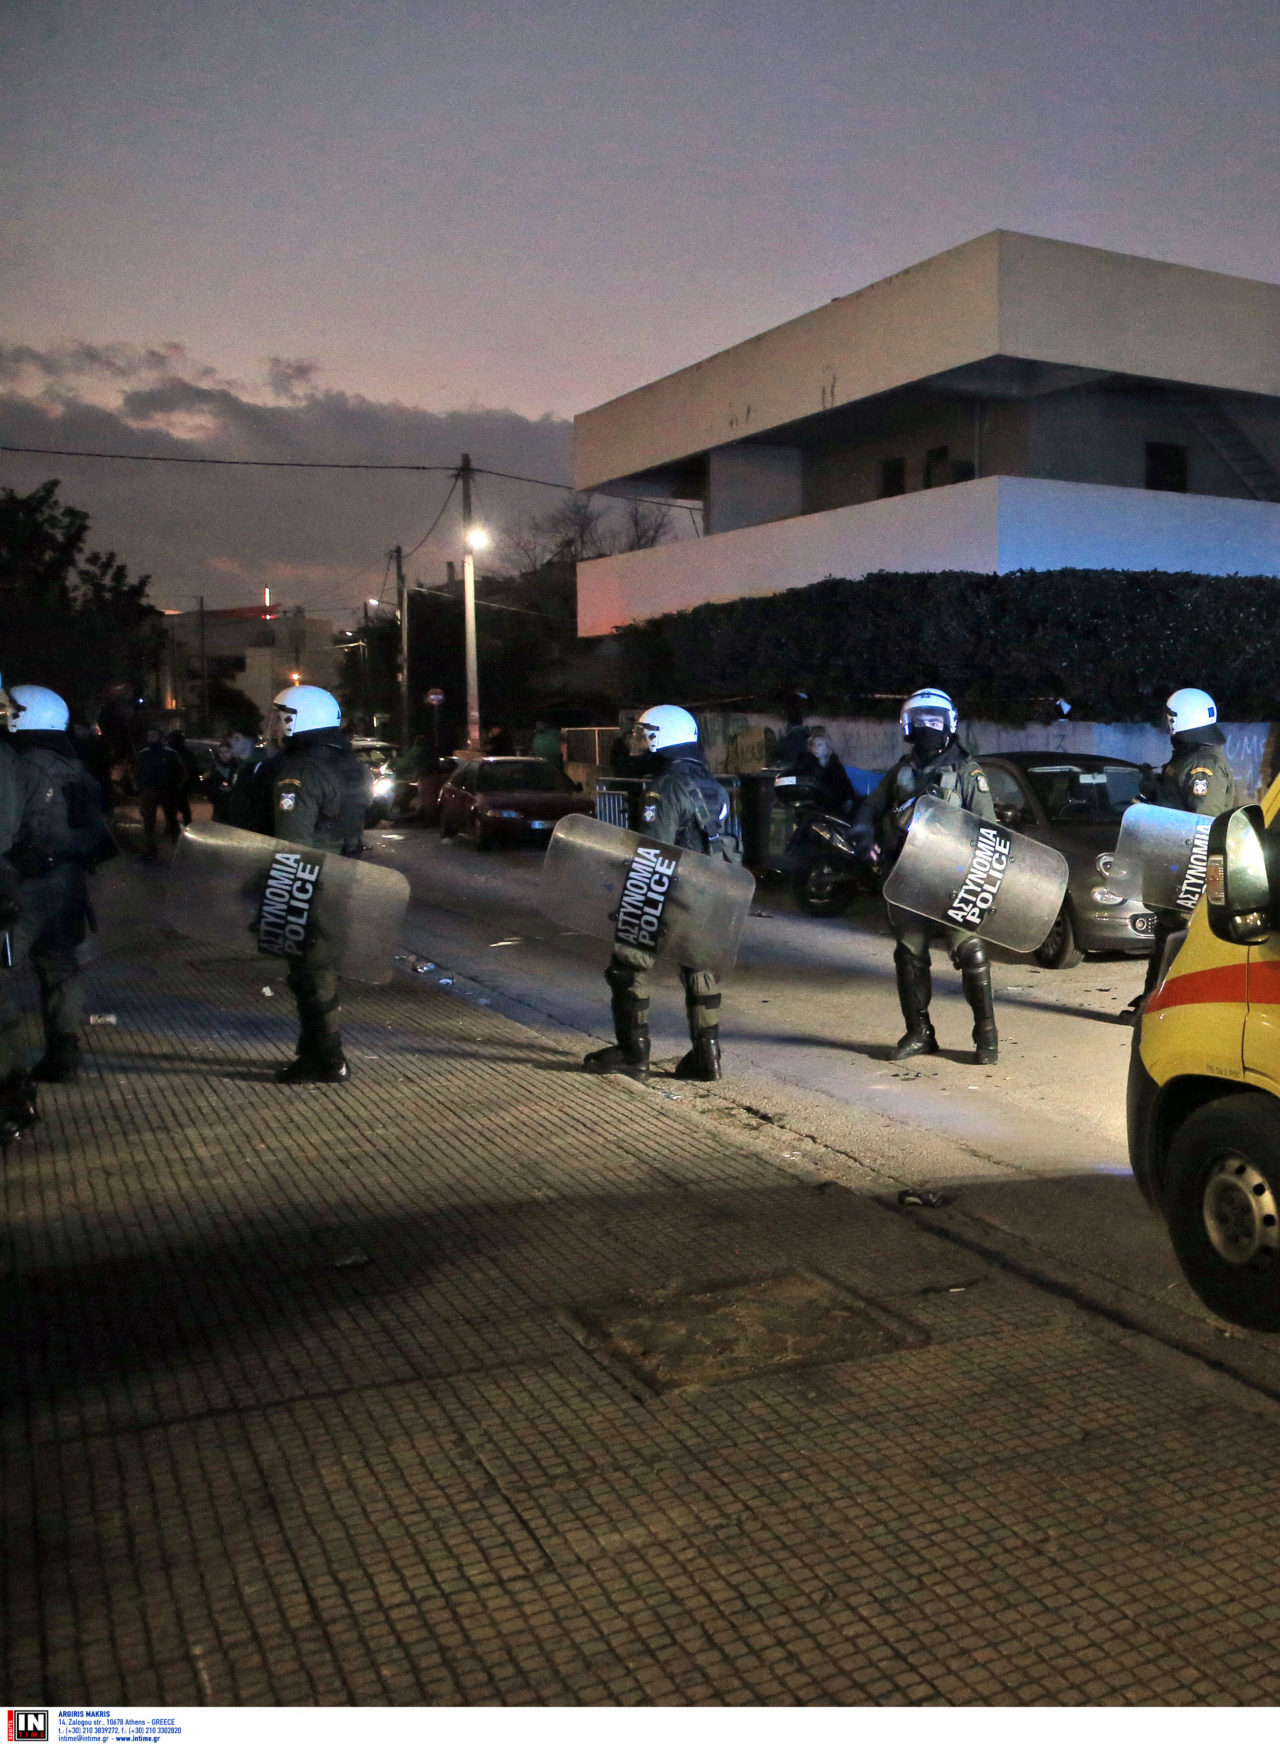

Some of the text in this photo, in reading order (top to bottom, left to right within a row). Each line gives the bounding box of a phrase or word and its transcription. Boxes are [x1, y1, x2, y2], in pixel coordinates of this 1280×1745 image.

[259, 853, 301, 953] ΑΣΤΥΝΟΜΙΑ
[284, 862, 319, 957] POLICE
[617, 847, 660, 944] ΑΣΤΥΝΟΜΙΑ
[639, 857, 676, 946] POLICE
[947, 828, 997, 922] ΑΣΤΥΝΟΜΙΑ
[966, 837, 1010, 924] POLICE
